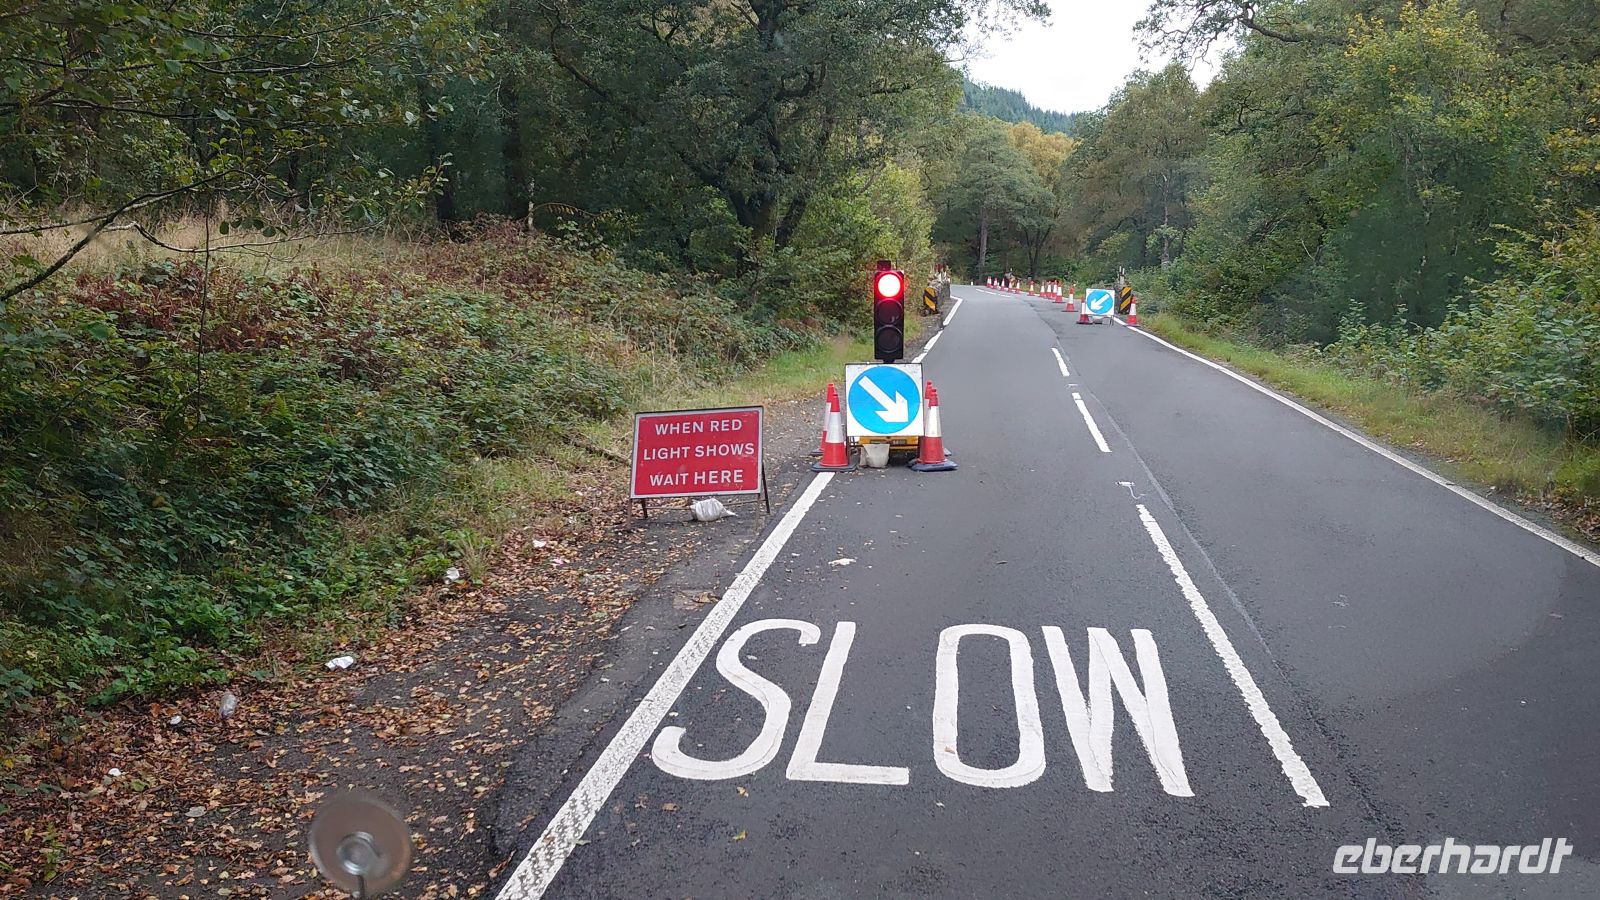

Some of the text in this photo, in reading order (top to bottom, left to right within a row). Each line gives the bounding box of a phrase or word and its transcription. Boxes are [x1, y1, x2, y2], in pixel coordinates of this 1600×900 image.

[655, 419, 742, 435] WHEN RED
[643, 443, 754, 460] LIGHT SHOWS
[649, 469, 743, 486] WAIT HERE
[651, 618, 1195, 797] SLOW
